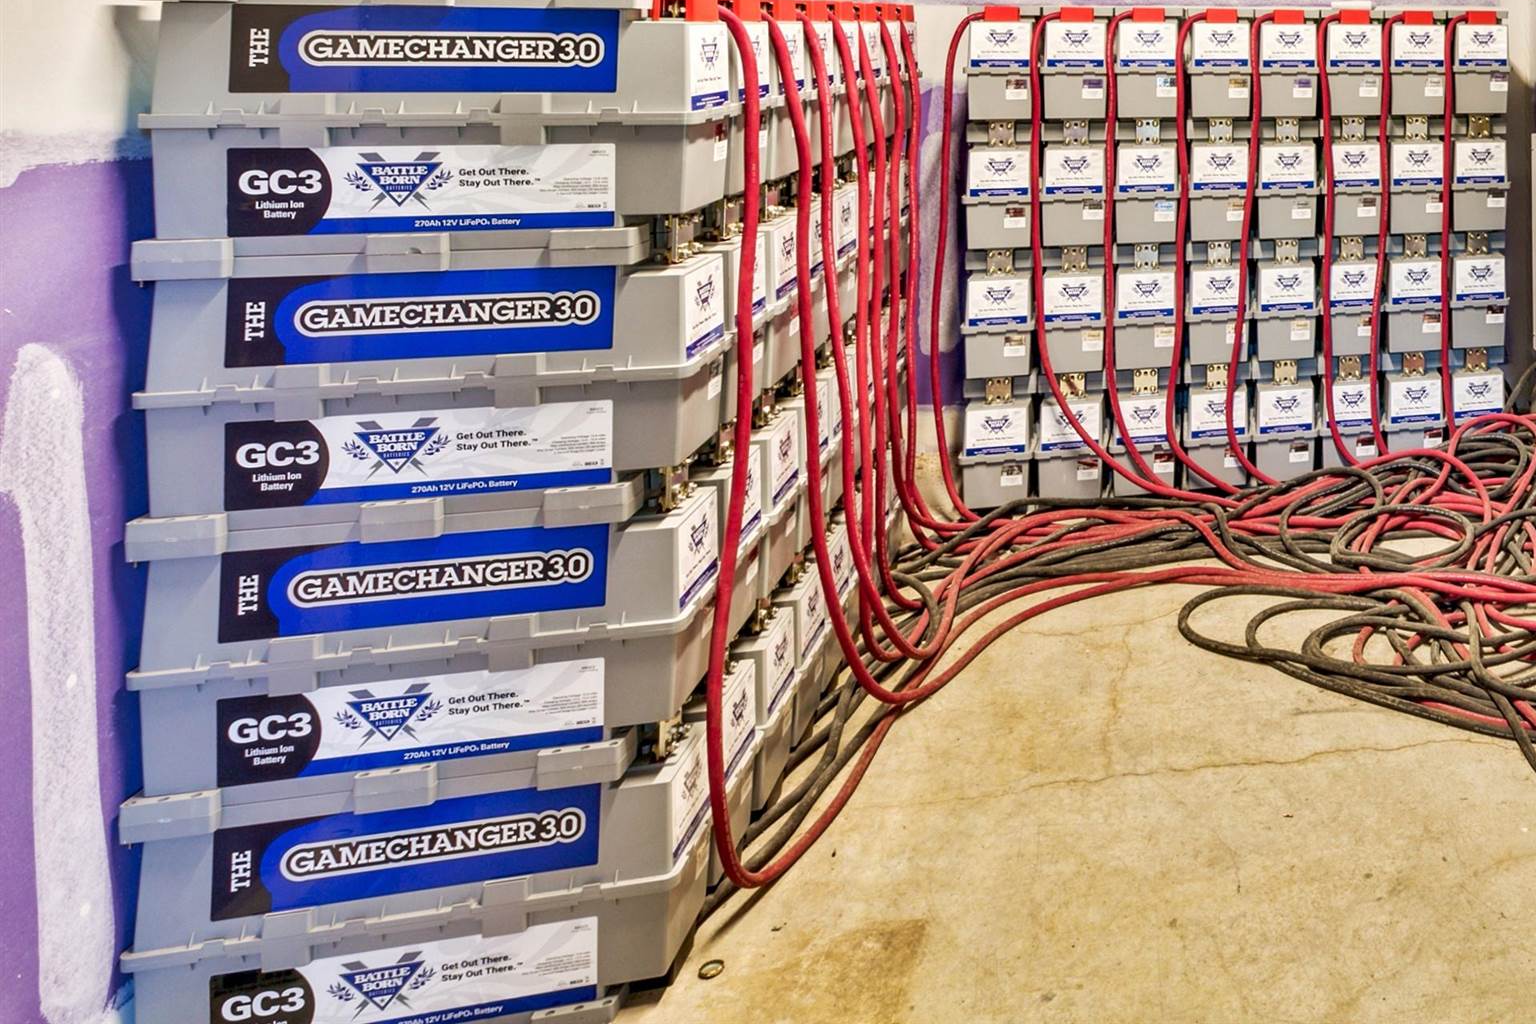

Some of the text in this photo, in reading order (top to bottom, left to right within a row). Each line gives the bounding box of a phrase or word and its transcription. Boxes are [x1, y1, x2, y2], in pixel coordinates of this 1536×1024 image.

[249, 28, 270, 67] THE
[308, 38, 597, 60] GAMECHANGER 3.0
[371, 166, 428, 176] BATTLE
[459, 168, 529, 176] Get Out There.
[238, 170, 322, 194] GC3
[379, 176, 420, 185] BORN
[459, 179, 482, 188] Stay
[484, 178, 500, 187] Out
[256, 201, 288, 210] Lithium
[264, 210, 296, 220] Battery
[492, 218, 521, 226] Battery
[304, 298, 593, 330] GAMECHANGER 3.0
[244, 302, 266, 342] THE
[368, 431, 426, 444] BATTLE
[456, 428, 527, 440] Get Out There.
[376, 442, 419, 453] BORN
[456, 442, 478, 452] Stay
[480, 441, 498, 449] Out
[236, 440, 320, 468] GC3
[252, 472, 302, 482] Lithium Ion
[260, 482, 294, 492] Battery
[412, 485, 438, 494] 270Ah
[440, 484, 455, 492] 12V
[488, 479, 518, 488] Battery
[297, 554, 586, 600] GAMECHANGER 3.0
[237, 574, 259, 616] THE
[448, 690, 519, 705] Get Out There.
[360, 698, 418, 712] BATTLE
[448, 708, 470, 716] Stay
[472, 705, 490, 713] Out
[369, 708, 411, 720] BORN
[228, 712, 312, 744] GC3
[244, 744, 294, 758] Lithium Ion
[404, 751, 431, 760] 270Ah
[432, 748, 448, 757] 12V
[480, 742, 510, 752] Battery
[252, 756, 286, 766] Battery
[290, 814, 579, 873] GAMECHANGER 3.0
[230, 850, 252, 893] THE
[442, 962, 459, 972] Get
[462, 960, 478, 968] Out
[480, 954, 512, 965] There.
[354, 966, 411, 984] BATTLE
[442, 972, 464, 982] Stay
[466, 970, 484, 979] Out
[362, 976, 403, 992] BORN
[221, 987, 305, 1022] GC3
[474, 1005, 503, 1016] Battery
